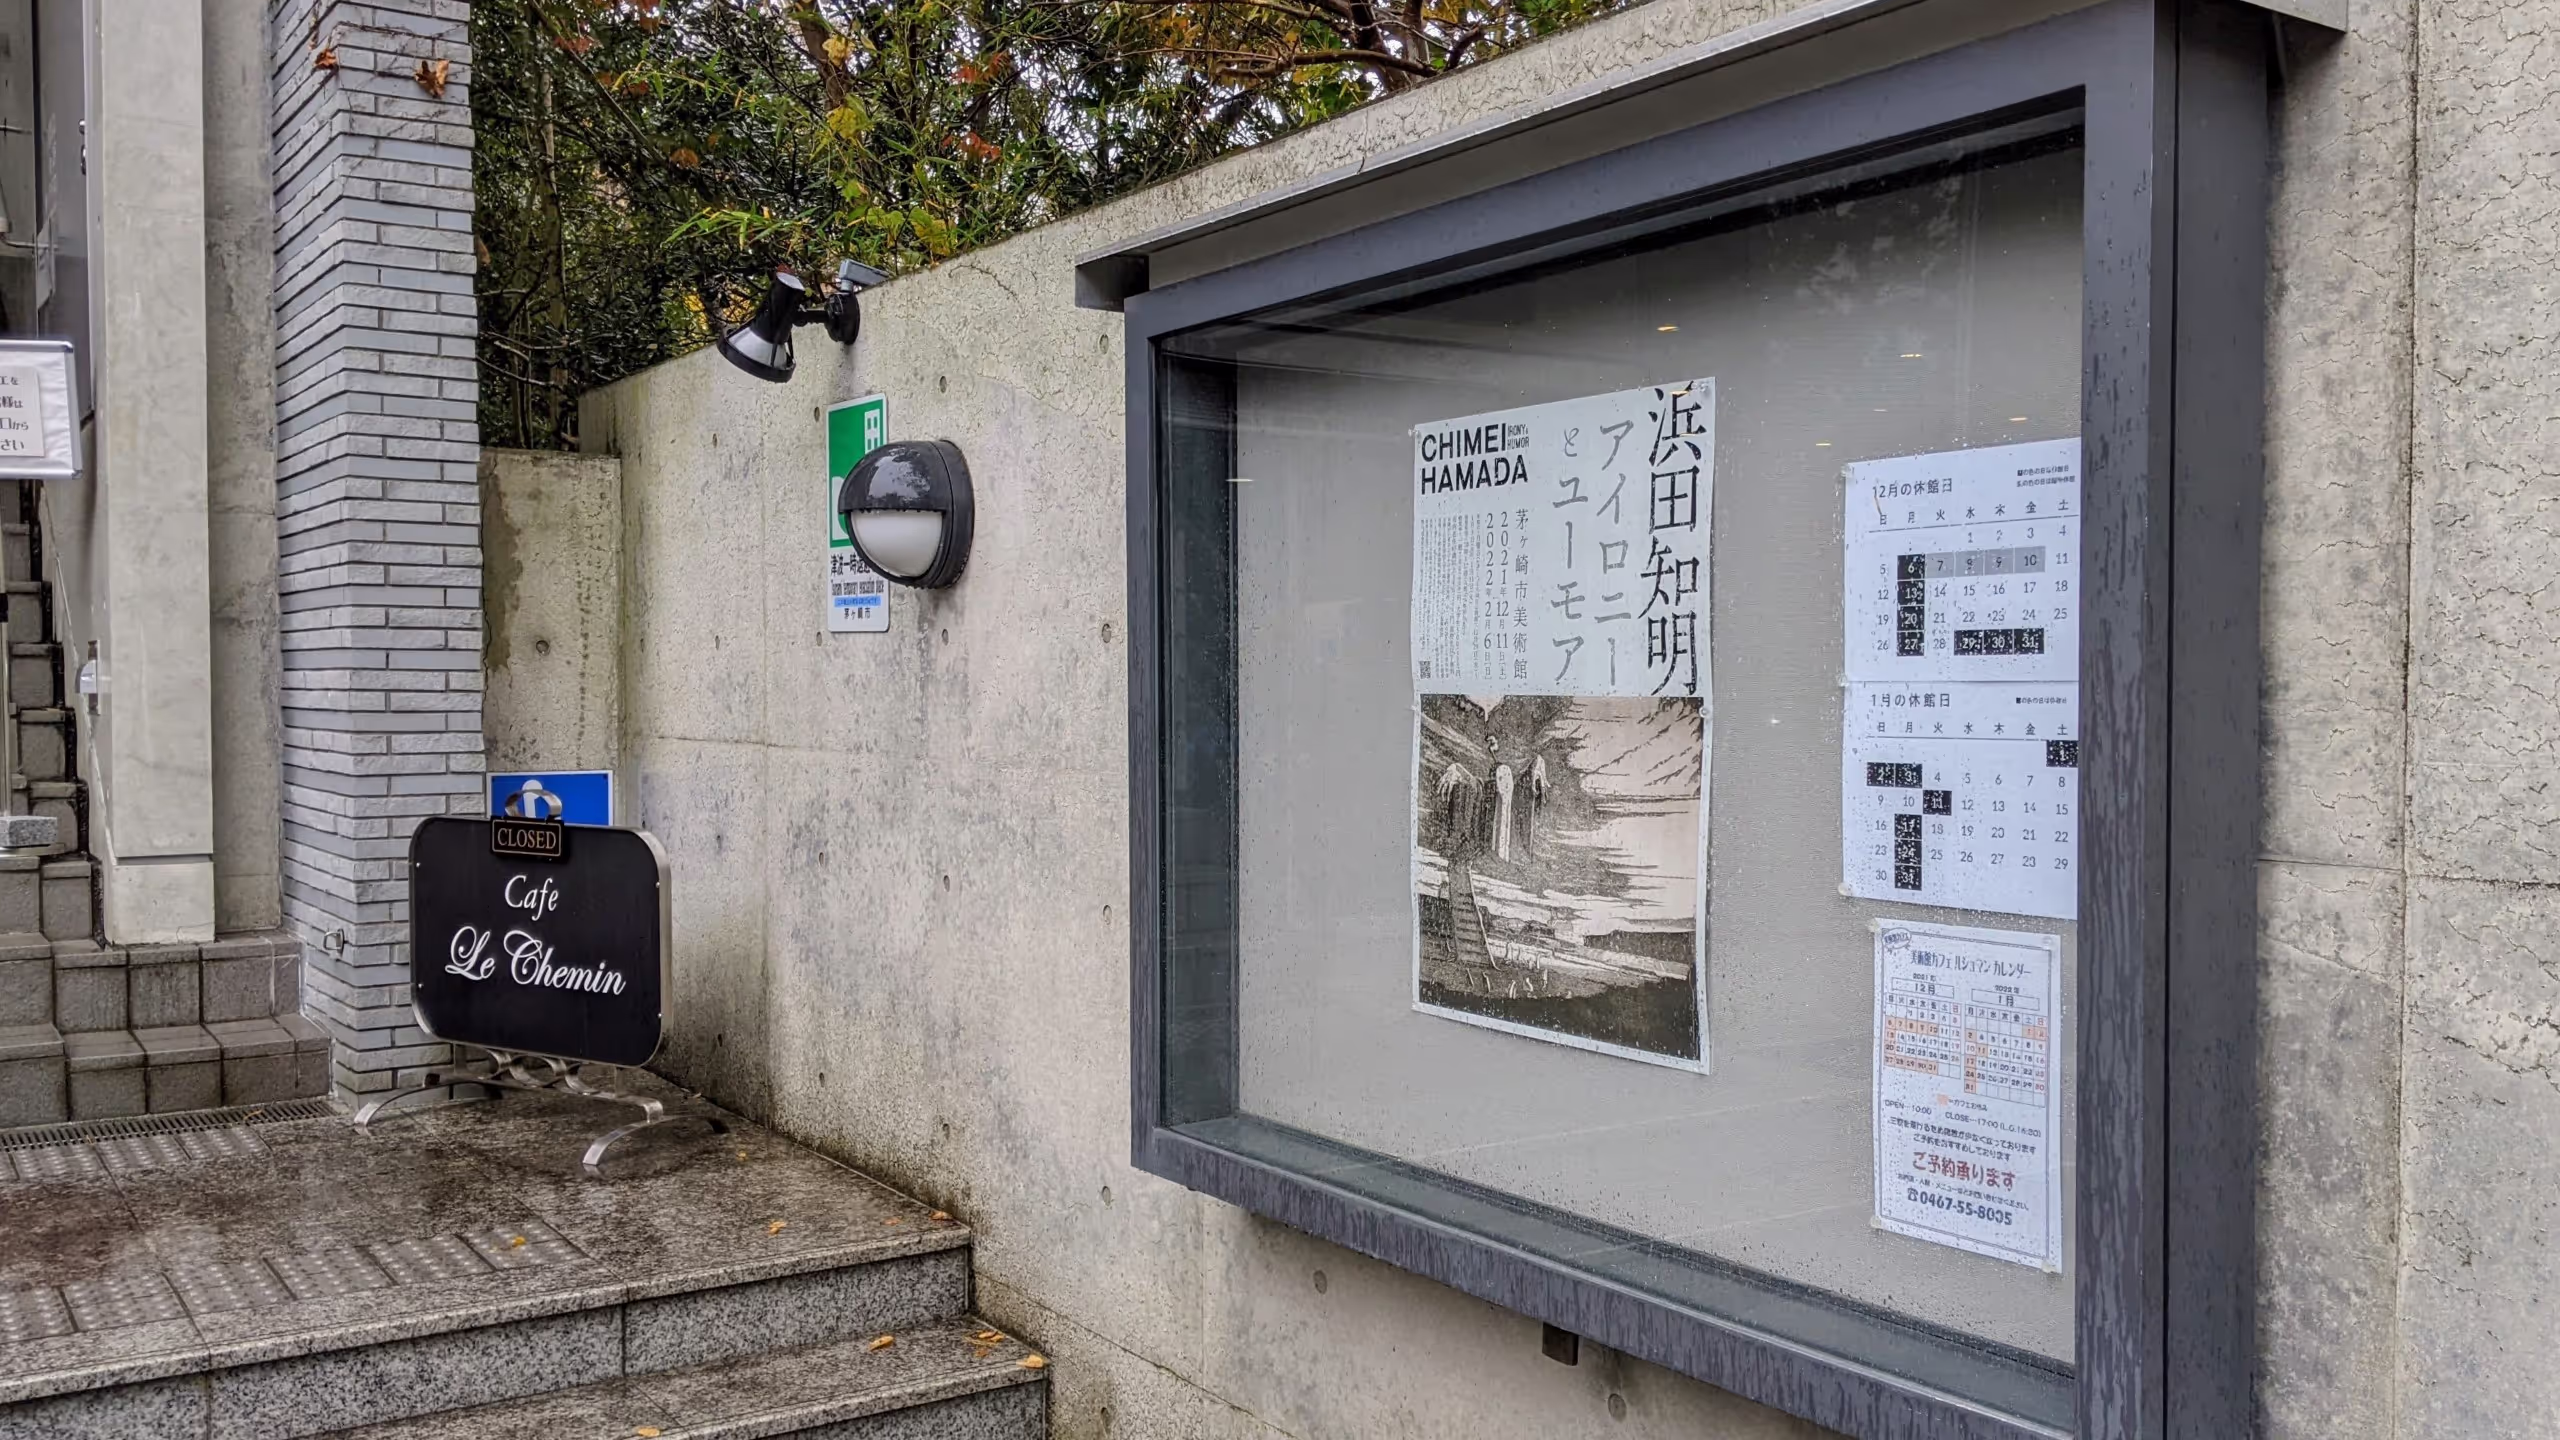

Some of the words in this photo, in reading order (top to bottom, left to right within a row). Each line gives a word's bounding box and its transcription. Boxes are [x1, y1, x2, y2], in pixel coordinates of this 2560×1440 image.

[0, 395, 23, 408] 様は
[1421, 423, 1506, 462] CHIMEI
[1421, 454, 1528, 495] HAMADA
[1872, 477, 1953, 498] 12月の休館日
[1880, 514, 1887, 525] 日
[1936, 509, 1945, 521] 火
[1966, 506, 1975, 519] 水
[2025, 501, 2036, 514] 金
[2058, 499, 2069, 511] 土
[1638, 381, 1707, 695] 浜田知明
[1968, 532, 1973, 543] 1
[2027, 527, 2034, 539] 3
[1551, 428, 1589, 681] とユーモア
[1594, 420, 1634, 686] アイロニー
[1880, 564, 1886, 575] 5
[1908, 562, 1915, 573] 6
[1937, 560, 1943, 571] 7
[2024, 555, 2037, 566] 10
[2056, 552, 2069, 565] 11
[1513, 509, 1529, 680] 茅ヶ崎市美術館
[1878, 590, 1889, 600] 12
[1934, 586, 1946, 597] 14
[1963, 585, 1975, 596] 15
[1993, 583, 2005, 595] 16
[2023, 582, 2036, 593] 17
[2055, 580, 2068, 592] 18
[1878, 614, 1889, 625] 19
[1934, 612, 1945, 623] 21
[1963, 611, 1975, 622] 22
[1992, 610, 2005, 621] 23
[2022, 609, 2036, 621] 24
[2054, 608, 2067, 620] 25
[1877, 640, 1888, 650] 26
[1933, 638, 1945, 649] 28
[1992, 637, 2004, 648] 30
[2022, 636, 2036, 648] 31
[1871, 693, 1950, 708] 1月の休館日
[1878, 722, 1885, 733] 日
[1905, 721, 1913, 733] 月
[1933, 722, 1943, 733] 火
[1963, 722, 1973, 734] 水
[1994, 722, 2004, 735] 木
[2025, 723, 2036, 735] 金
[2057, 724, 2068, 736] 土
[1906, 771, 1912, 781] 3
[1934, 772, 1941, 782] 4
[1964, 773, 1970, 784] 5
[1996, 774, 2002, 785] 6
[2027, 775, 2033, 786] 7
[2059, 777, 2065, 787] 8
[1878, 795, 1884, 806] 9
[1903, 797, 1914, 807] 10
[1961, 800, 1973, 811] 12
[1993, 801, 2005, 812] 13
[2024, 802, 2036, 813] 14
[2056, 804, 2068, 815] 15
[497, 828, 556, 849] CLOSED
[1876, 820, 1886, 830] 16
[1961, 826, 1974, 836] 19
[2023, 829, 2036, 840] 21
[2055, 831, 2068, 842] 22
[1875, 845, 1887, 855] 23
[1931, 849, 1942, 860] 25
[1961, 852, 1973, 862] 26
[2054, 858, 2068, 870] 29
[1876, 870, 1887, 881] 30
[504, 875, 558, 921] Cafe
[444, 926, 496, 980] Le
[503, 930, 626, 995] Chemin
[1912, 1151, 2016, 1192] ご予約承ります
